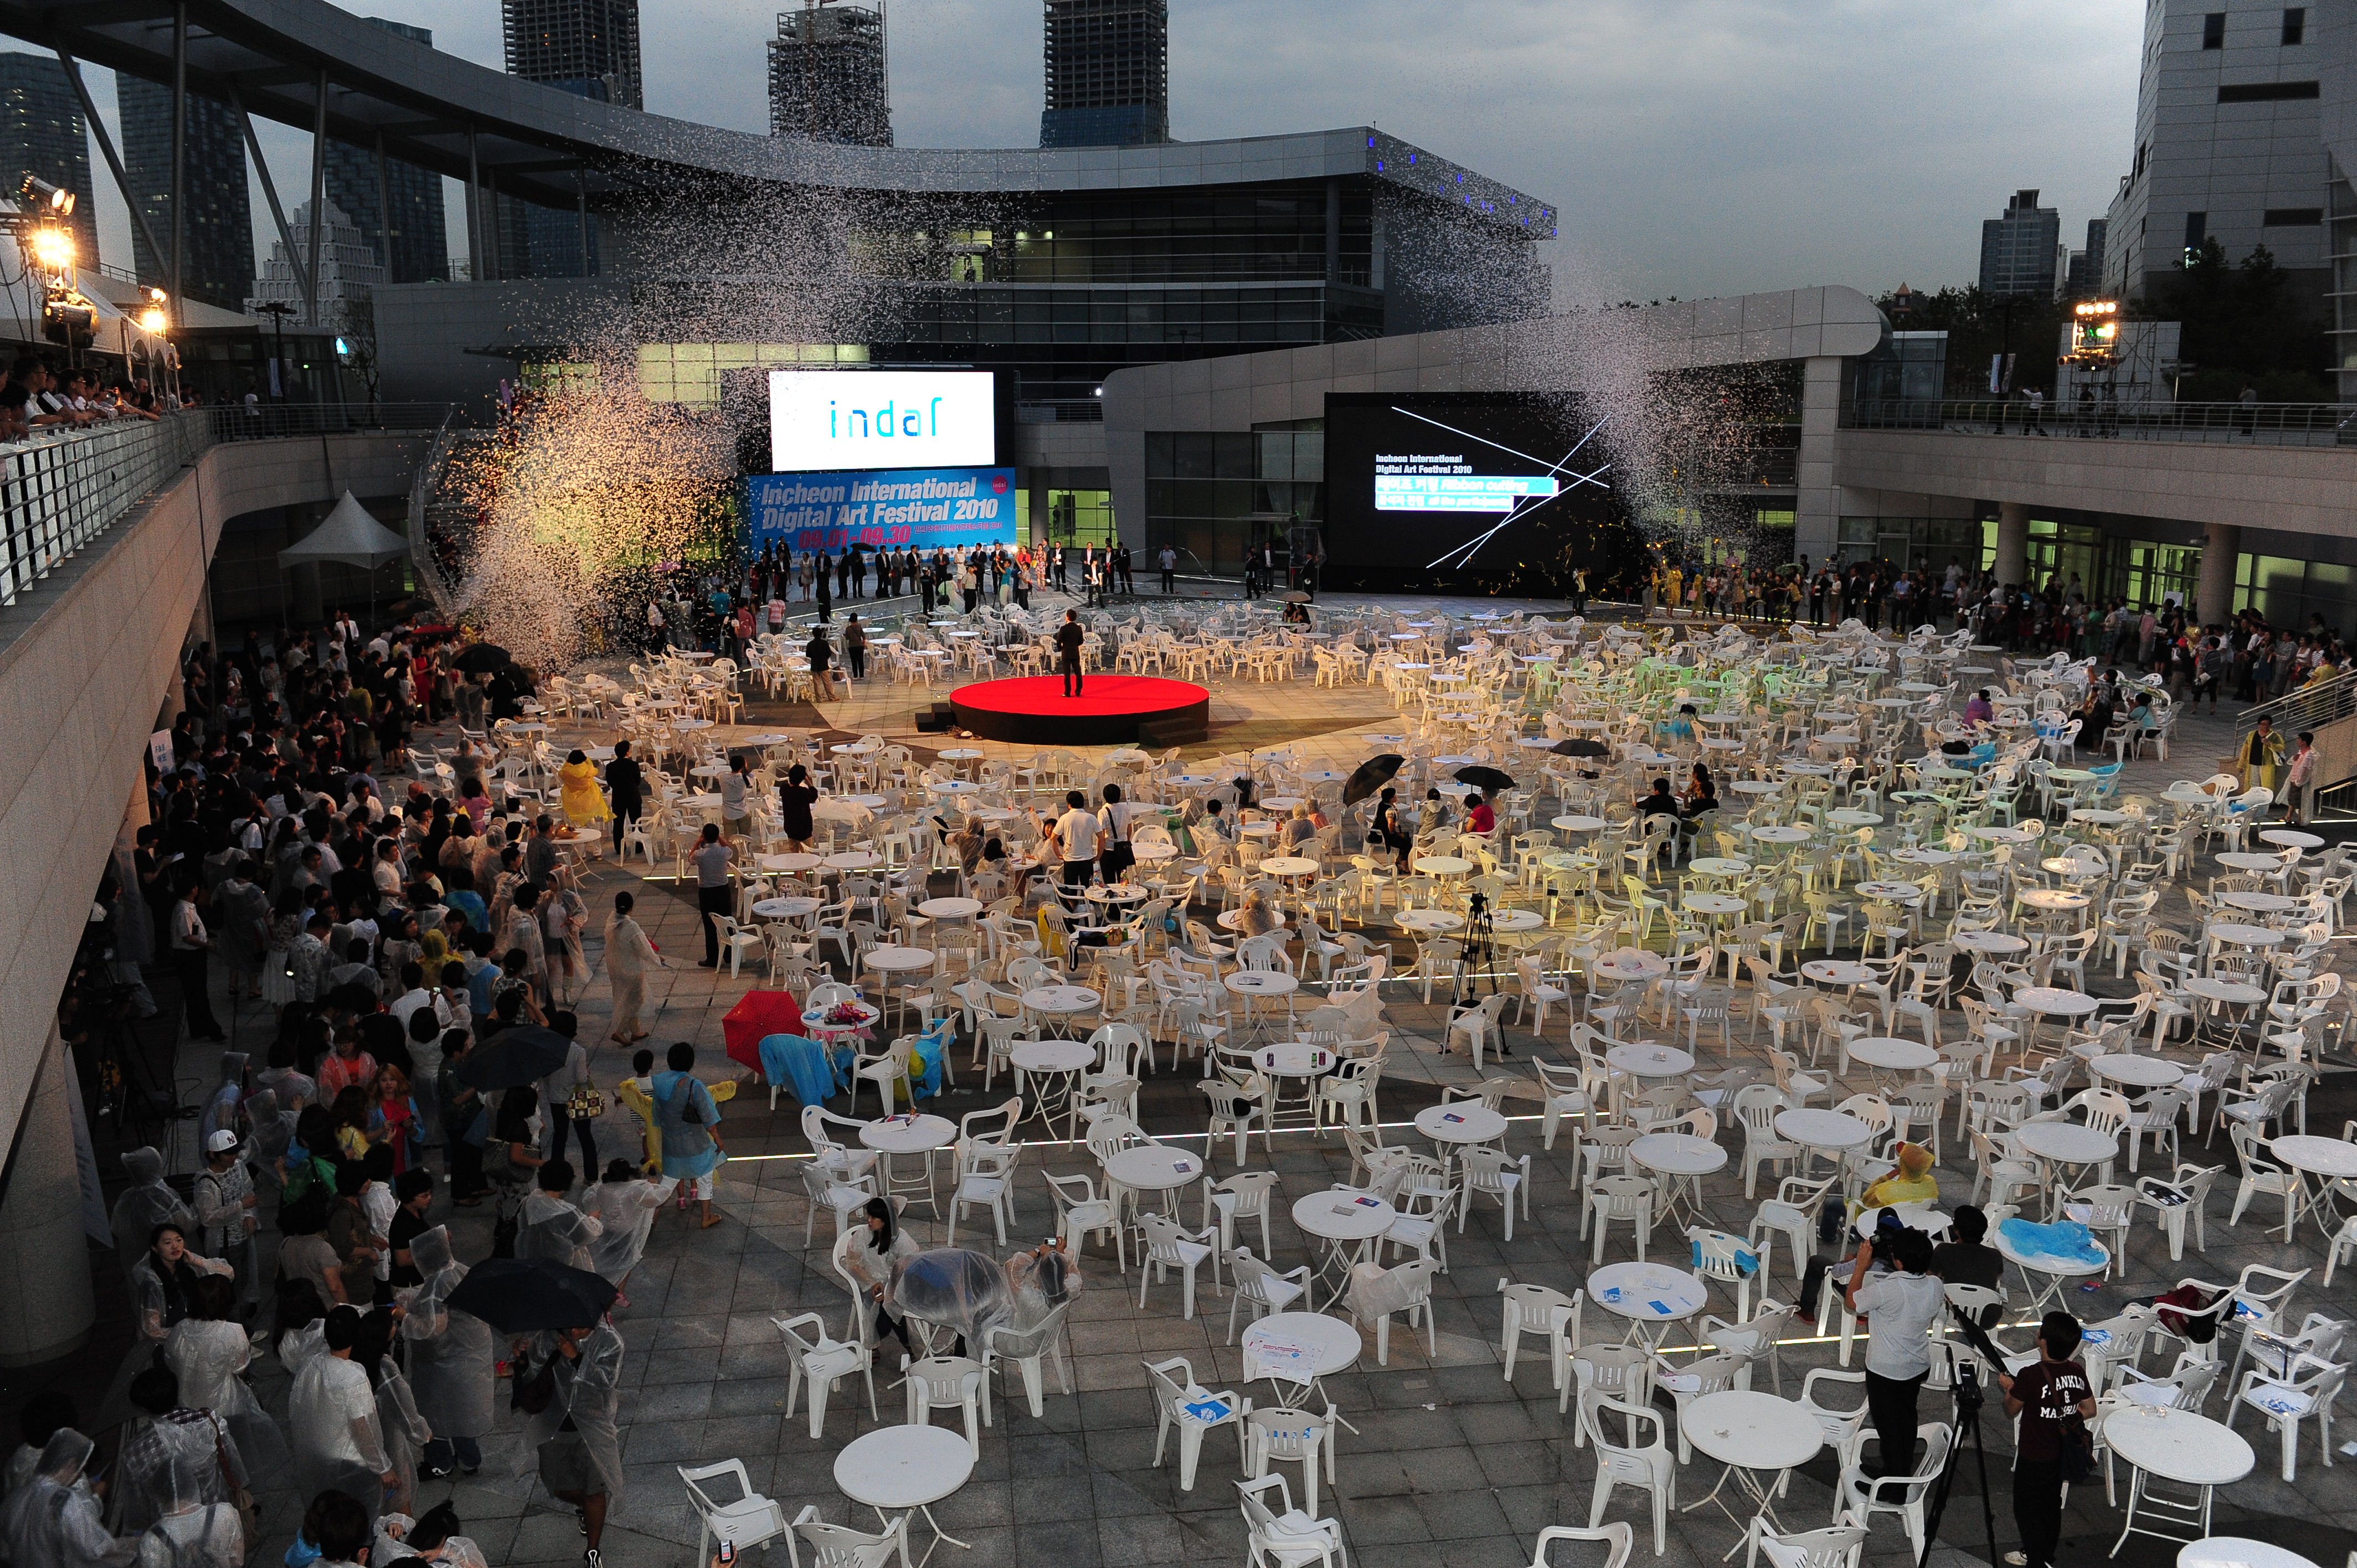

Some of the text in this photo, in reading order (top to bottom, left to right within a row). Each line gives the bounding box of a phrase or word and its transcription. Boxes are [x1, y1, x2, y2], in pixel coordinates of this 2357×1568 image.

[1410, 455, 1463, 463] International
[1376, 465, 1402, 474] Digital
[1419, 465, 1451, 473] Festival
[761, 477, 977, 505] Incheon International
[1377, 477, 1529, 493] 테이프 커팅 Ribbon cutting
[762, 498, 999, 533] Digital Art Festival 2010
[2064, 1390, 2070, 1403] &
